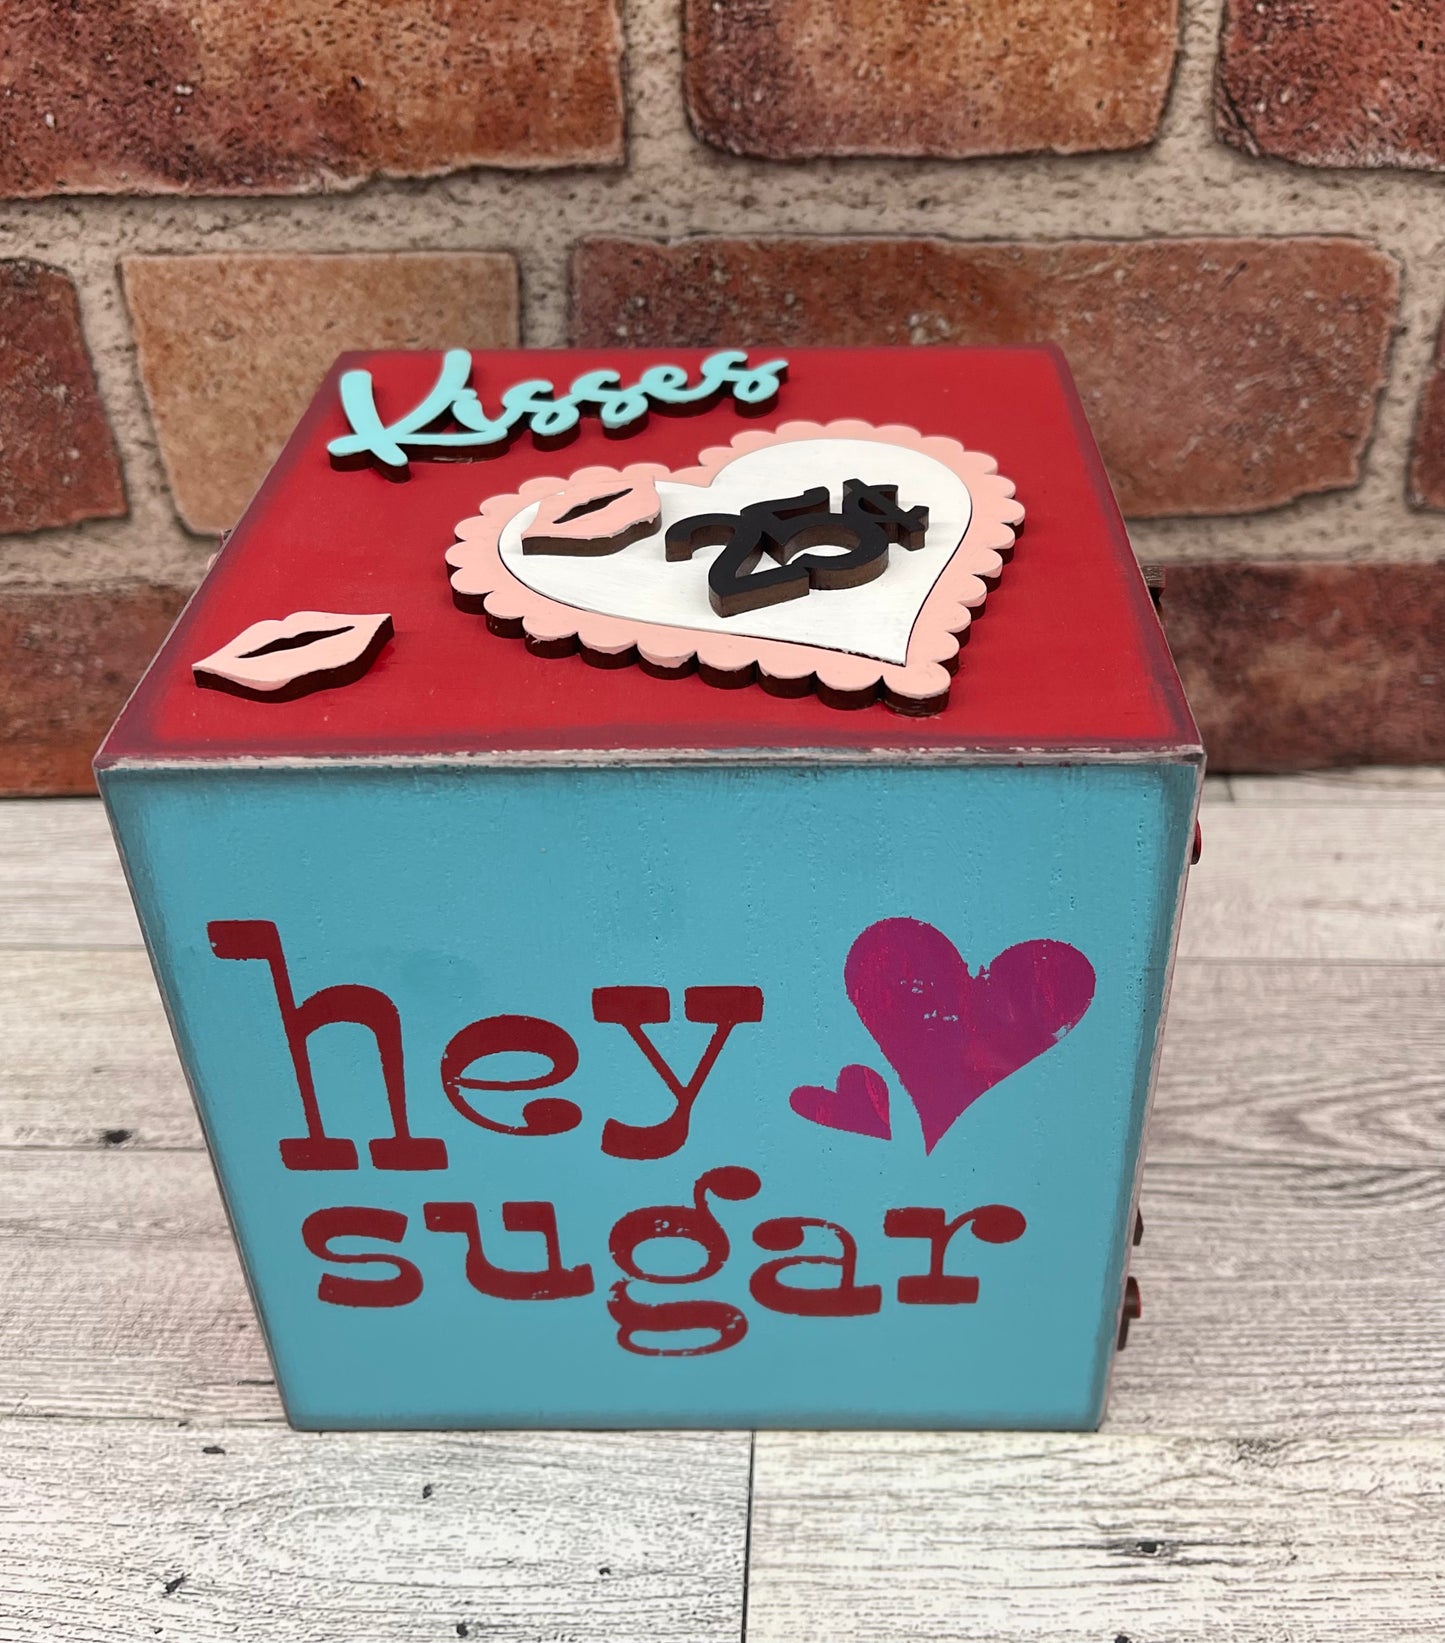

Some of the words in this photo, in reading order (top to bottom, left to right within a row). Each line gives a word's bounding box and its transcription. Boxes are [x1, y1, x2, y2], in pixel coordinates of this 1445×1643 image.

[327, 349, 789, 470] Kisses
[665, 478, 930, 617] 25¢
[207, 920, 764, 1171] hey
[301, 1165, 1027, 1357] sugar
